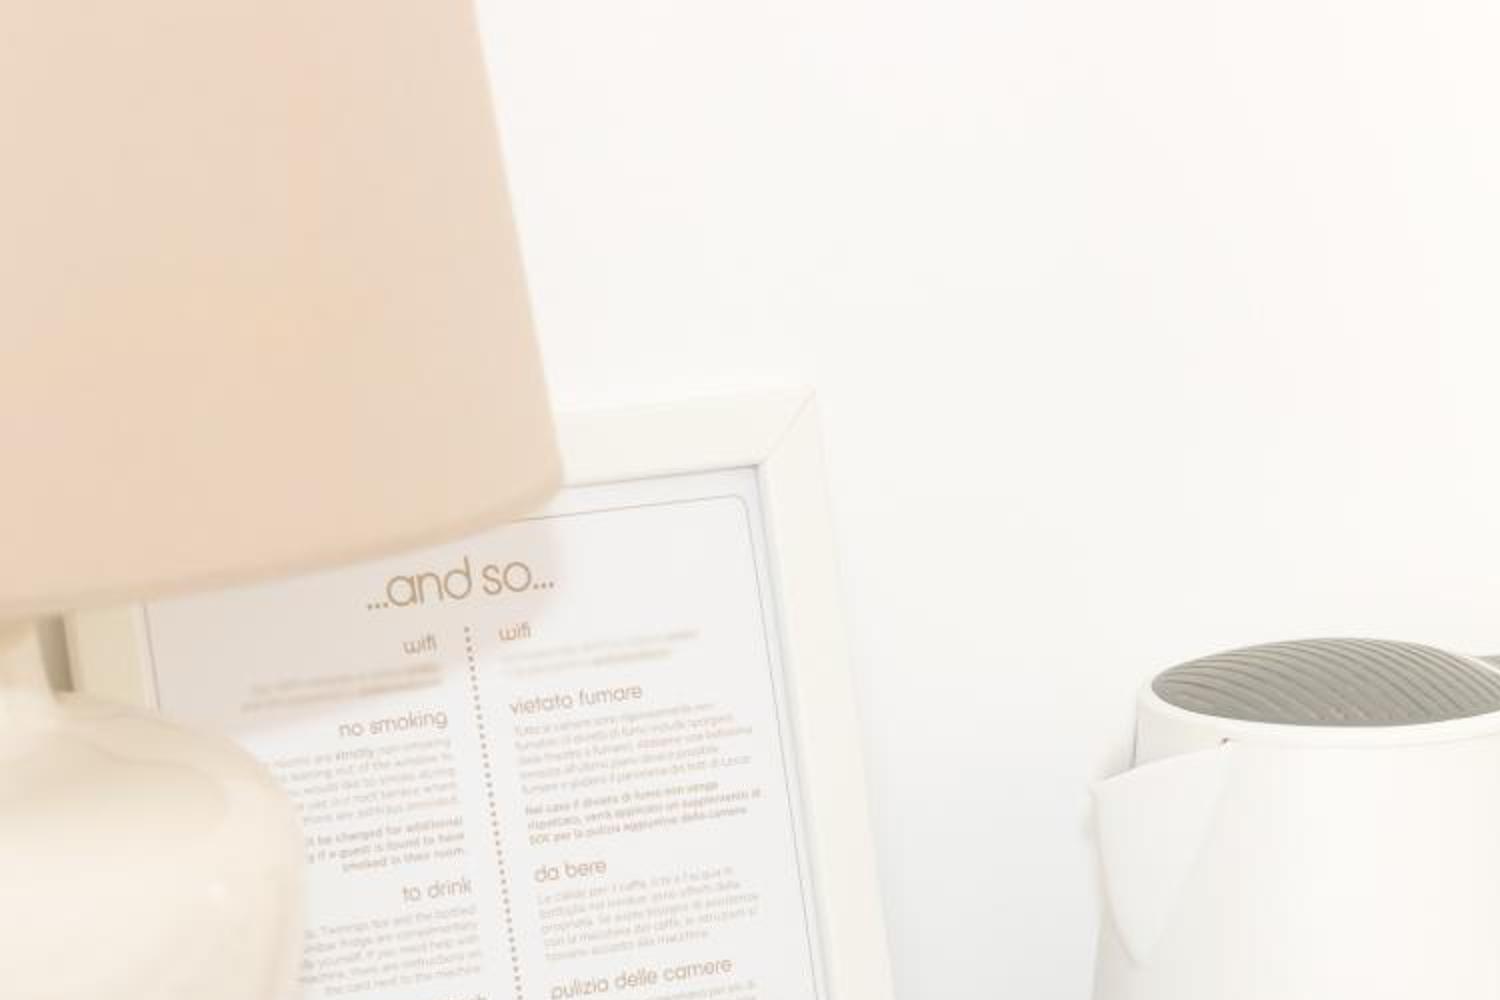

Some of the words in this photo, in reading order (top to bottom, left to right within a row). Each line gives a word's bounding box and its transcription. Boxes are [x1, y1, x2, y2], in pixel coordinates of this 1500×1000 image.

[366, 556, 472, 610] ...and
[481, 561, 555, 596] so...
[402, 634, 437, 654] wifi
[499, 622, 531, 642] wifi
[508, 692, 574, 715] vietato
[578, 682, 643, 706] fumare
[338, 721, 365, 738] no
[368, 707, 449, 737] smoking
[533, 865, 559, 883] da
[564, 858, 607, 878] bere
[401, 883, 421, 902] to
[426, 875, 473, 899] drink
[550, 977, 609, 1000] pulizia
[613, 967, 657, 989] delle
[662, 957, 733, 982] camere
